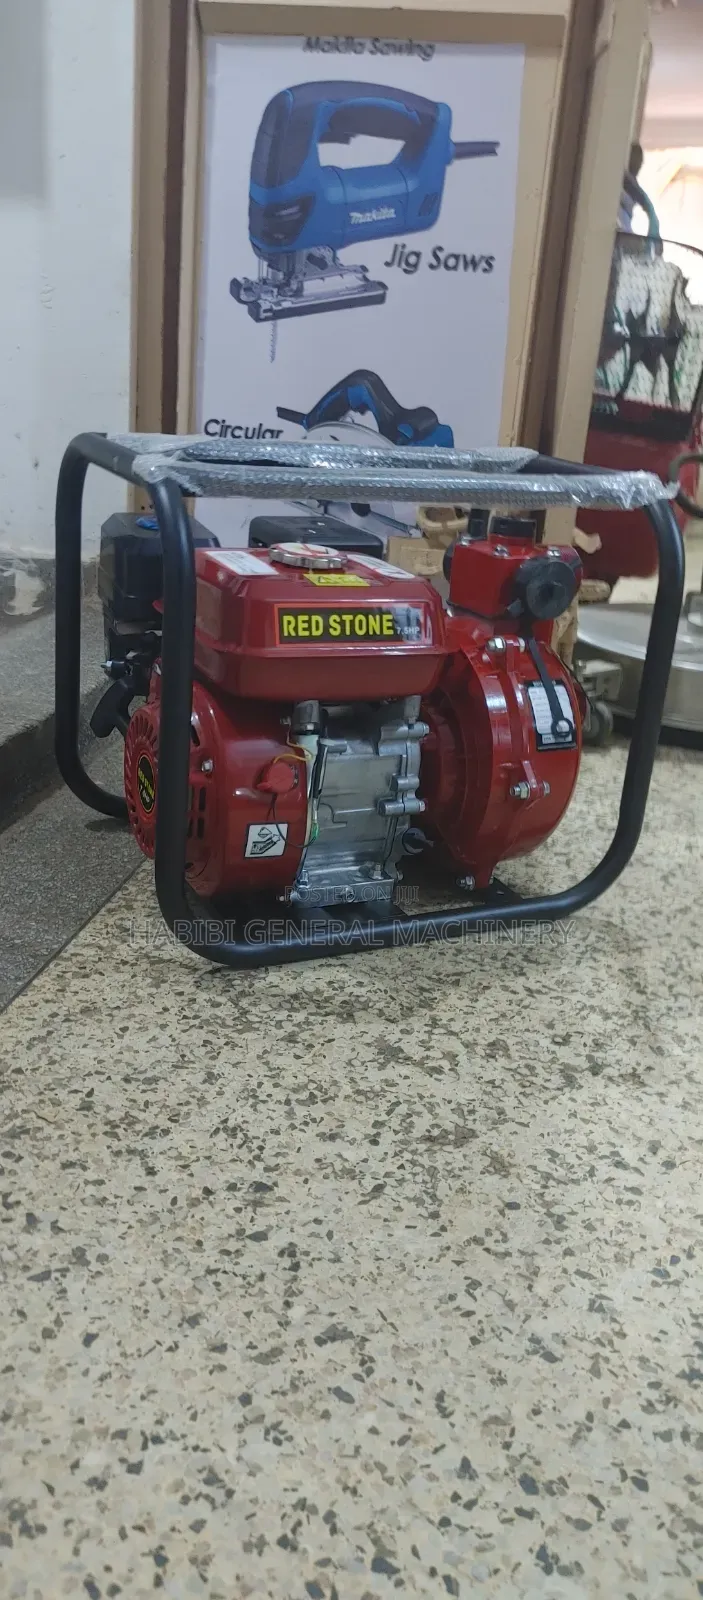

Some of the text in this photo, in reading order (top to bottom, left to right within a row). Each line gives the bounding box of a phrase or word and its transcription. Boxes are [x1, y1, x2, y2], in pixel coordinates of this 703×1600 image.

[368, 37, 436, 62] Sawing
[384, 243, 496, 275] Jig Saws
[204, 418, 284, 439] Circular
[283, 615, 324, 636] RED
[329, 614, 394, 636] STONE
